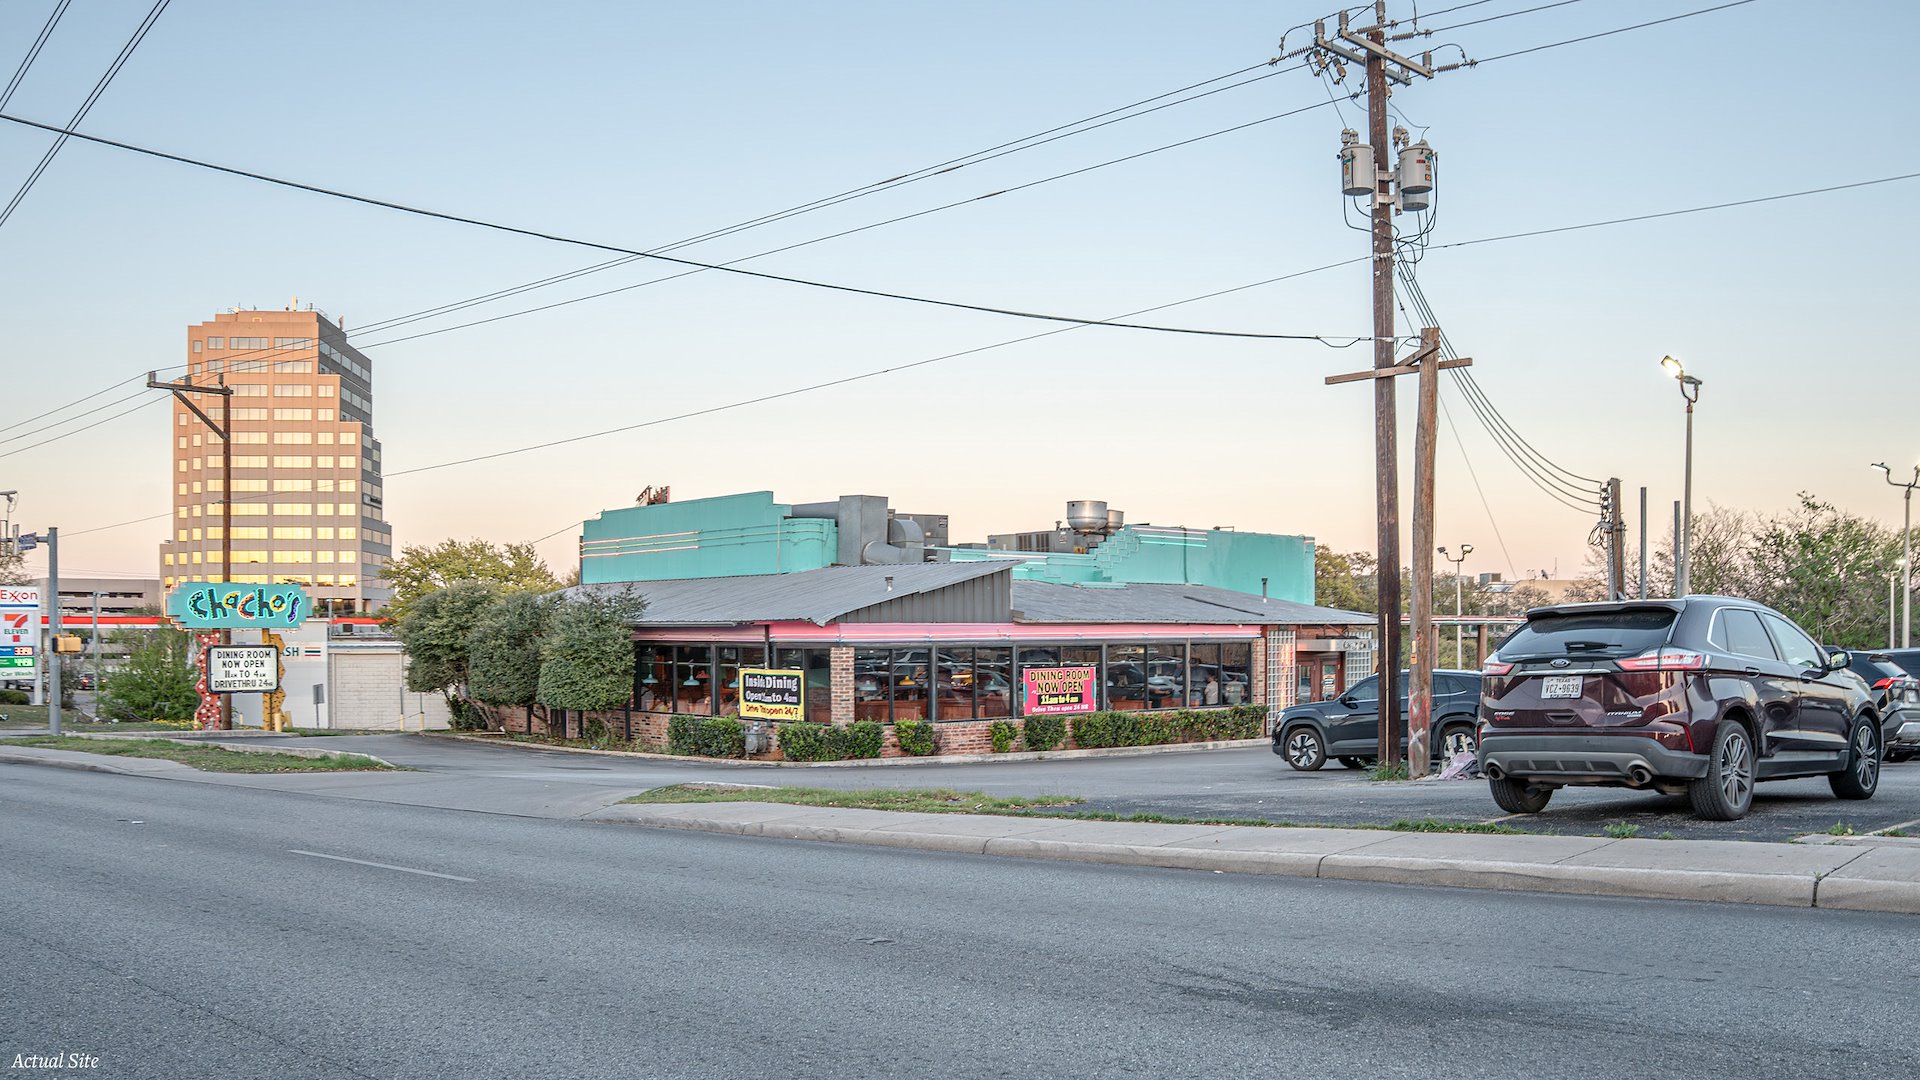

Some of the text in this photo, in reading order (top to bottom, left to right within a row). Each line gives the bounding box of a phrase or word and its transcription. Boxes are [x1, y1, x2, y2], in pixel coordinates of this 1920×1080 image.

[0, 589, 38, 603] Exxon
[217, 651, 271, 659] DINING ROOM
[244, 660, 265, 668] OPEN
[240, 670, 250, 678] TO
[1030, 670, 1090, 682] DINING ROOM
[215, 680, 256, 688] DRIVETHRU
[765, 676, 798, 692] Dining
[1038, 681, 1084, 693] NOW OPEN
[745, 690, 761, 702] Open
[772, 692, 782, 702] to
[1059, 694, 1065, 703] to
